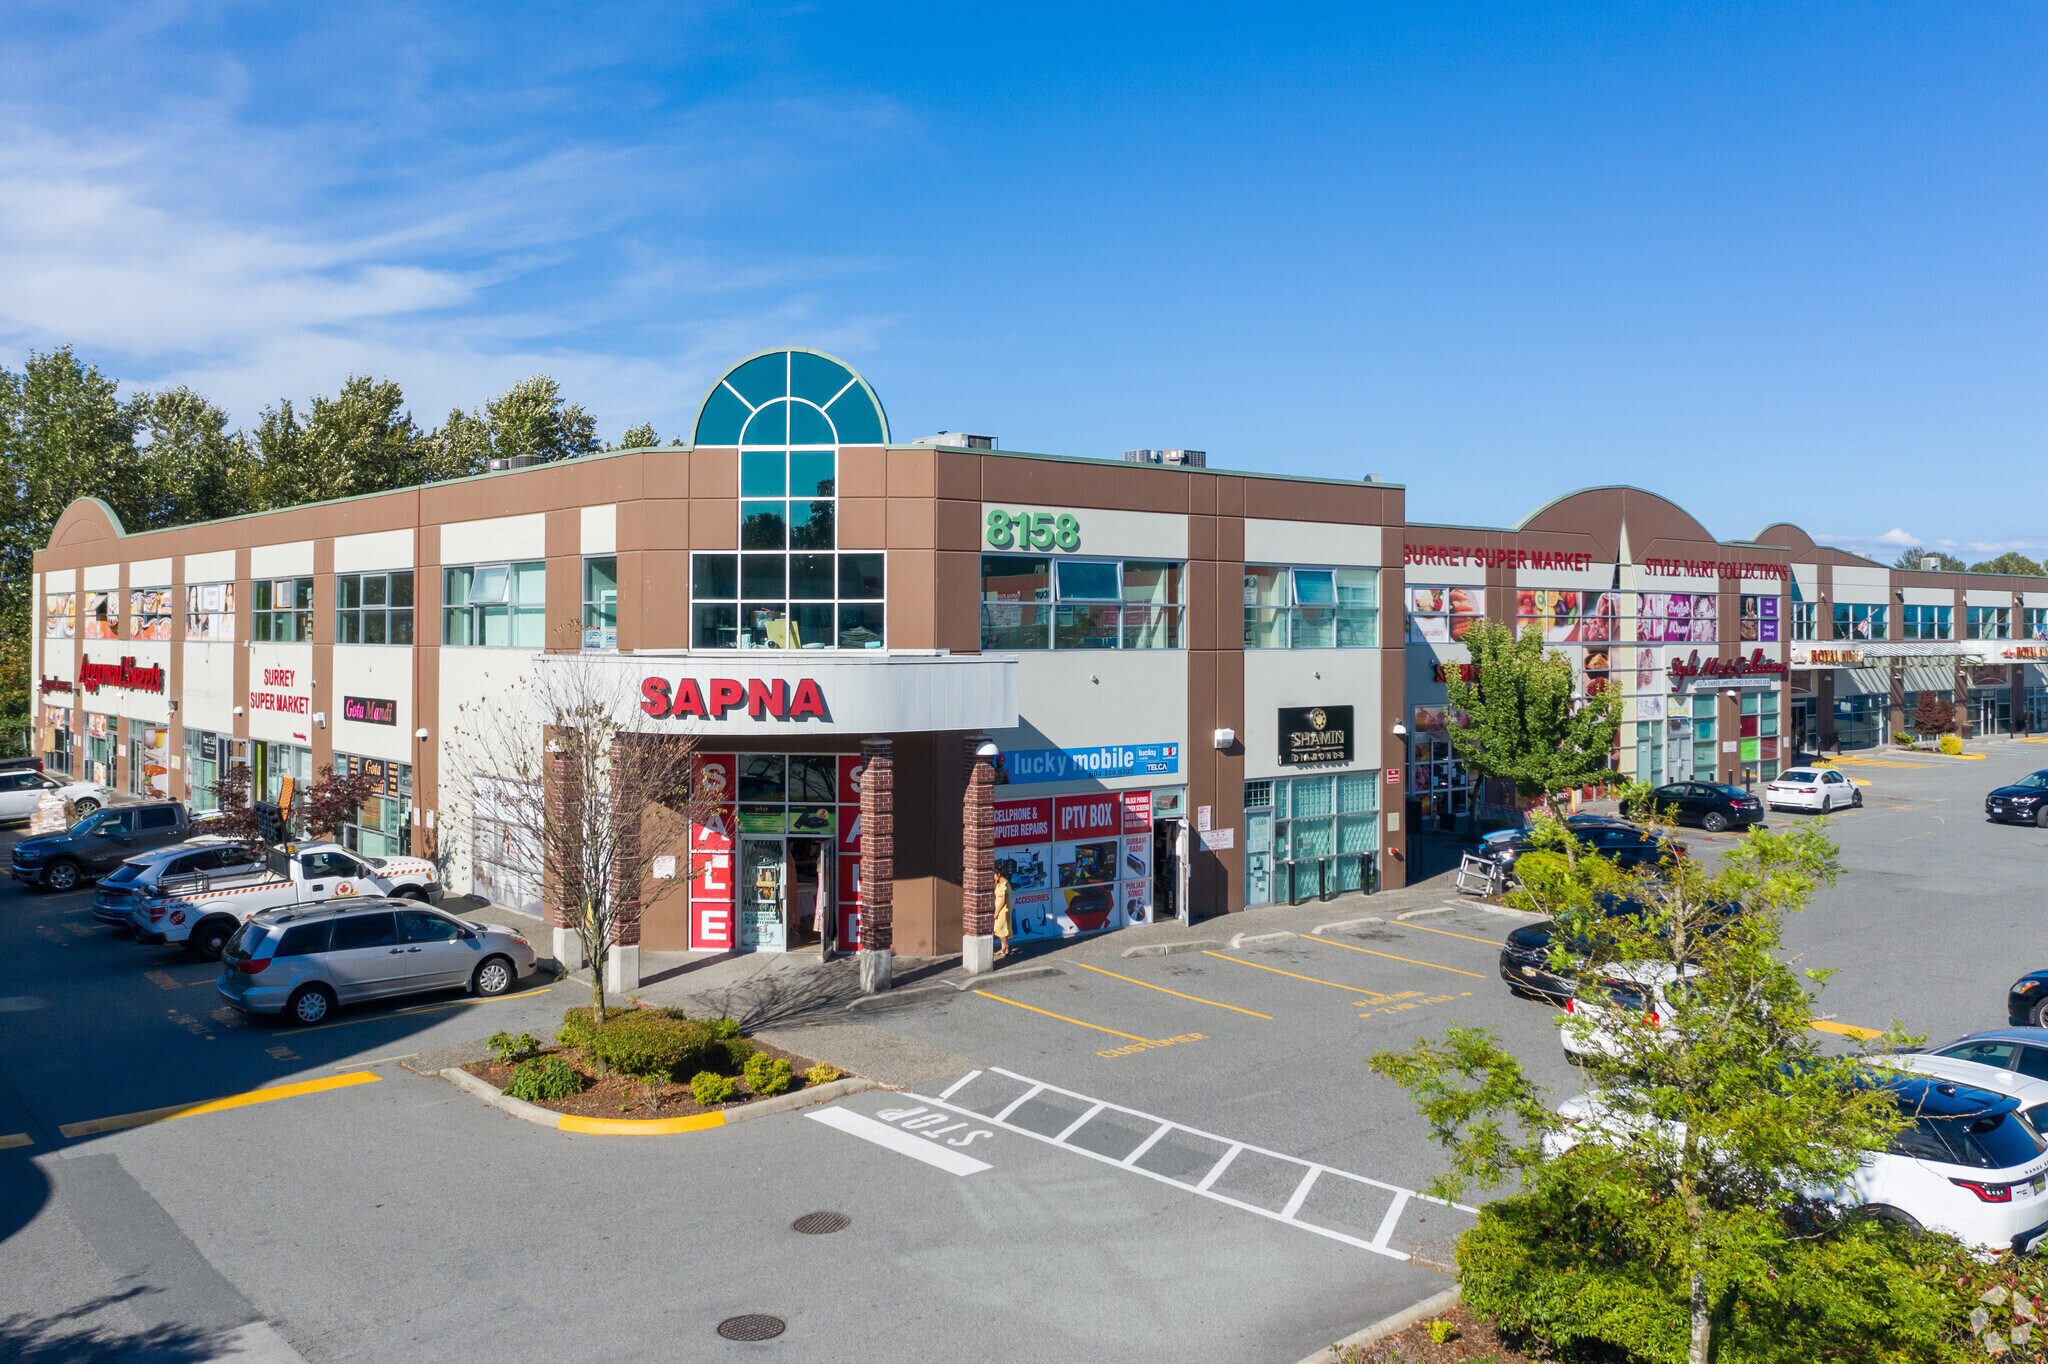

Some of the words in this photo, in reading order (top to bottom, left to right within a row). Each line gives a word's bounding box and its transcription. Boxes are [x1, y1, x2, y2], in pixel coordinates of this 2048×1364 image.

[986, 509, 1078, 548] 8158
[1404, 543, 1471, 567] SURREY
[1474, 547, 1527, 570] SUPER
[1531, 551, 1592, 572] MARKET
[1645, 558, 1681, 577] STYLE
[1683, 560, 1715, 578] MART
[1717, 562, 1788, 581] COLLECTIONS
[1810, 649, 1839, 664] ROYAL
[79, 655, 124, 692] Aggarwal
[124, 656, 160, 692] Sweets
[264, 668, 295, 688] SURREY
[250, 692, 275, 711] SUPER
[277, 694, 310, 715] MARKET
[640, 676, 825, 717] SAPNA
[346, 699, 364, 719] Gota
[366, 701, 392, 722] Mandi
[1292, 731, 1344, 746] SHAMIN
[1015, 751, 1067, 777] lucky
[1073, 747, 1134, 771] mobile
[1138, 749, 1156, 757] lucky
[365, 759, 381, 776] Gota
[1089, 768, 1134, 778] 604.344.0403
[994, 808, 1031, 823] CELLPHONE
[1032, 807, 1038, 818] &
[1061, 805, 1087, 830] IPTV
[1090, 803, 1113, 827] BOX
[994, 825, 1020, 840] MPUTER
[1020, 822, 1048, 836] REPAIRS
[1126, 837, 1147, 846] GURBANI
[1129, 845, 1144, 853] RADIO
[1126, 881, 1146, 890] PUNJABI
[1128, 889, 1143, 897] SONGS
[1015, 893, 1050, 906] ACCESSORIES
[171, 911, 184, 925] STOP
[1095, 1032, 1210, 1058] CUSTOMER
[876, 1106, 993, 1146] STOP
